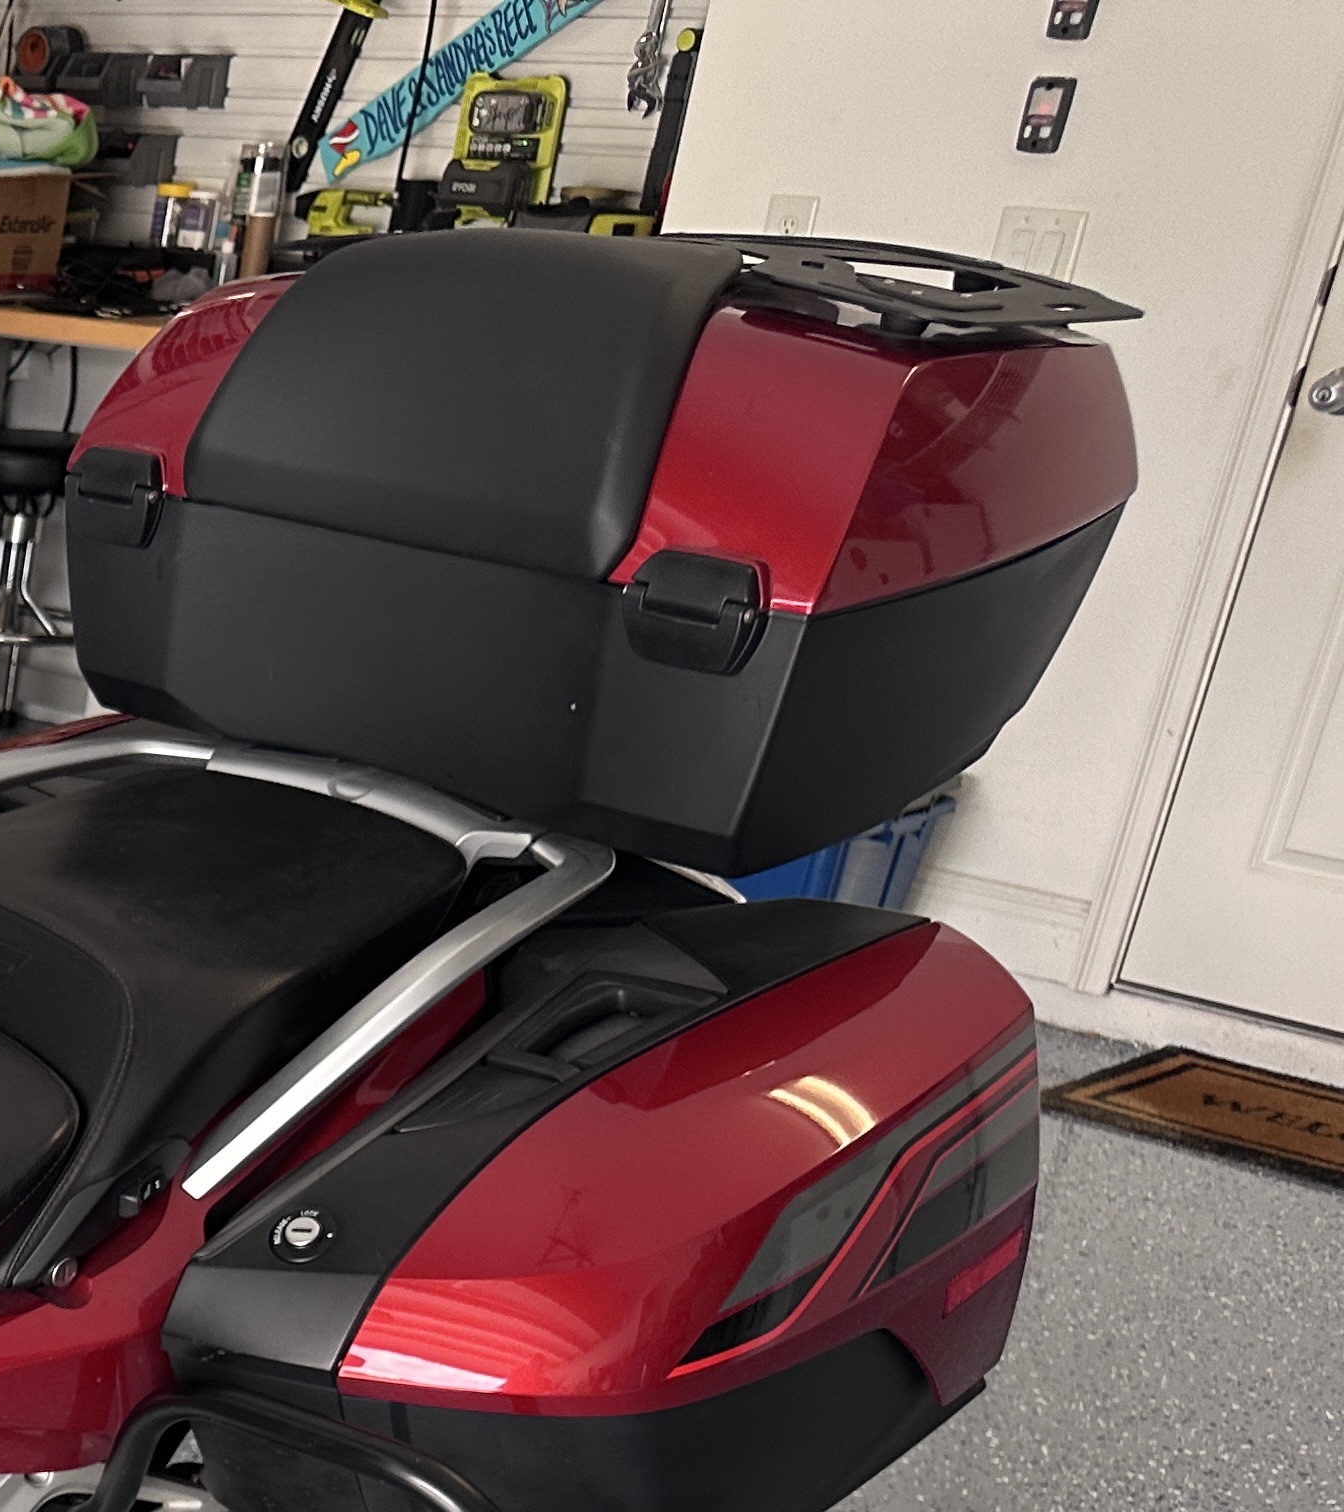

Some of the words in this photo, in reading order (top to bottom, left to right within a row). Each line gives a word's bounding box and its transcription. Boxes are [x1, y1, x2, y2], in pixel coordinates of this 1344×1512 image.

[358, 86, 408, 155] DAVE
[493, 0, 538, 57] REEF
[1202, 1094, 1344, 1141] WELC
